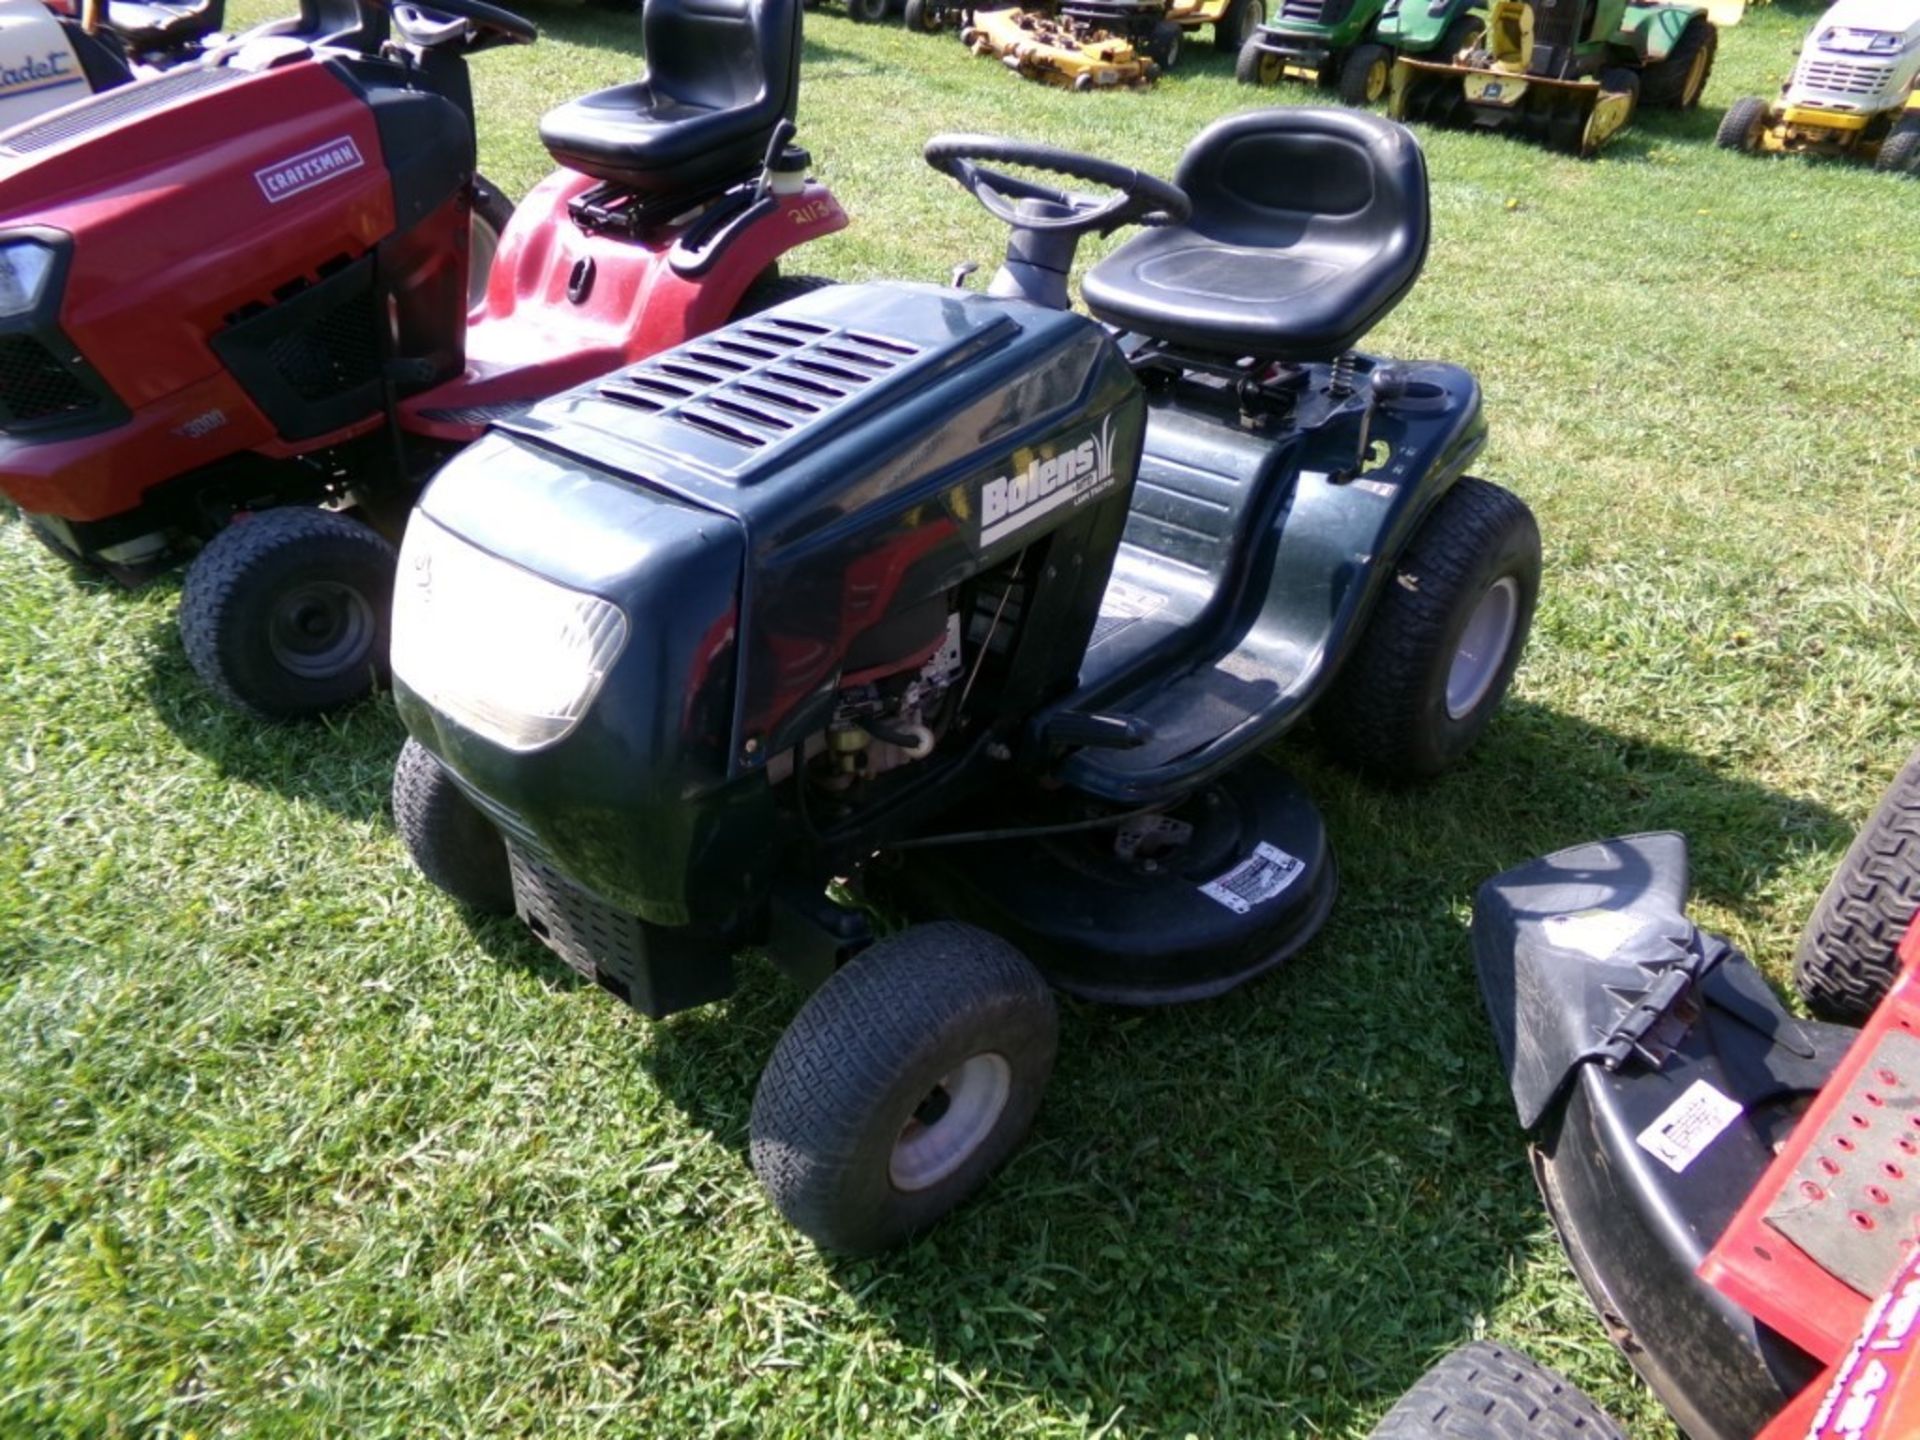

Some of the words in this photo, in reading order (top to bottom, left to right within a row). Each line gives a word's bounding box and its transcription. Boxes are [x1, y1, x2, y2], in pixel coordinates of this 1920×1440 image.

[0, 51, 69, 86] adet
[265, 145, 355, 193] CRAFTSMAN
[981, 438, 1095, 528] Bolens
